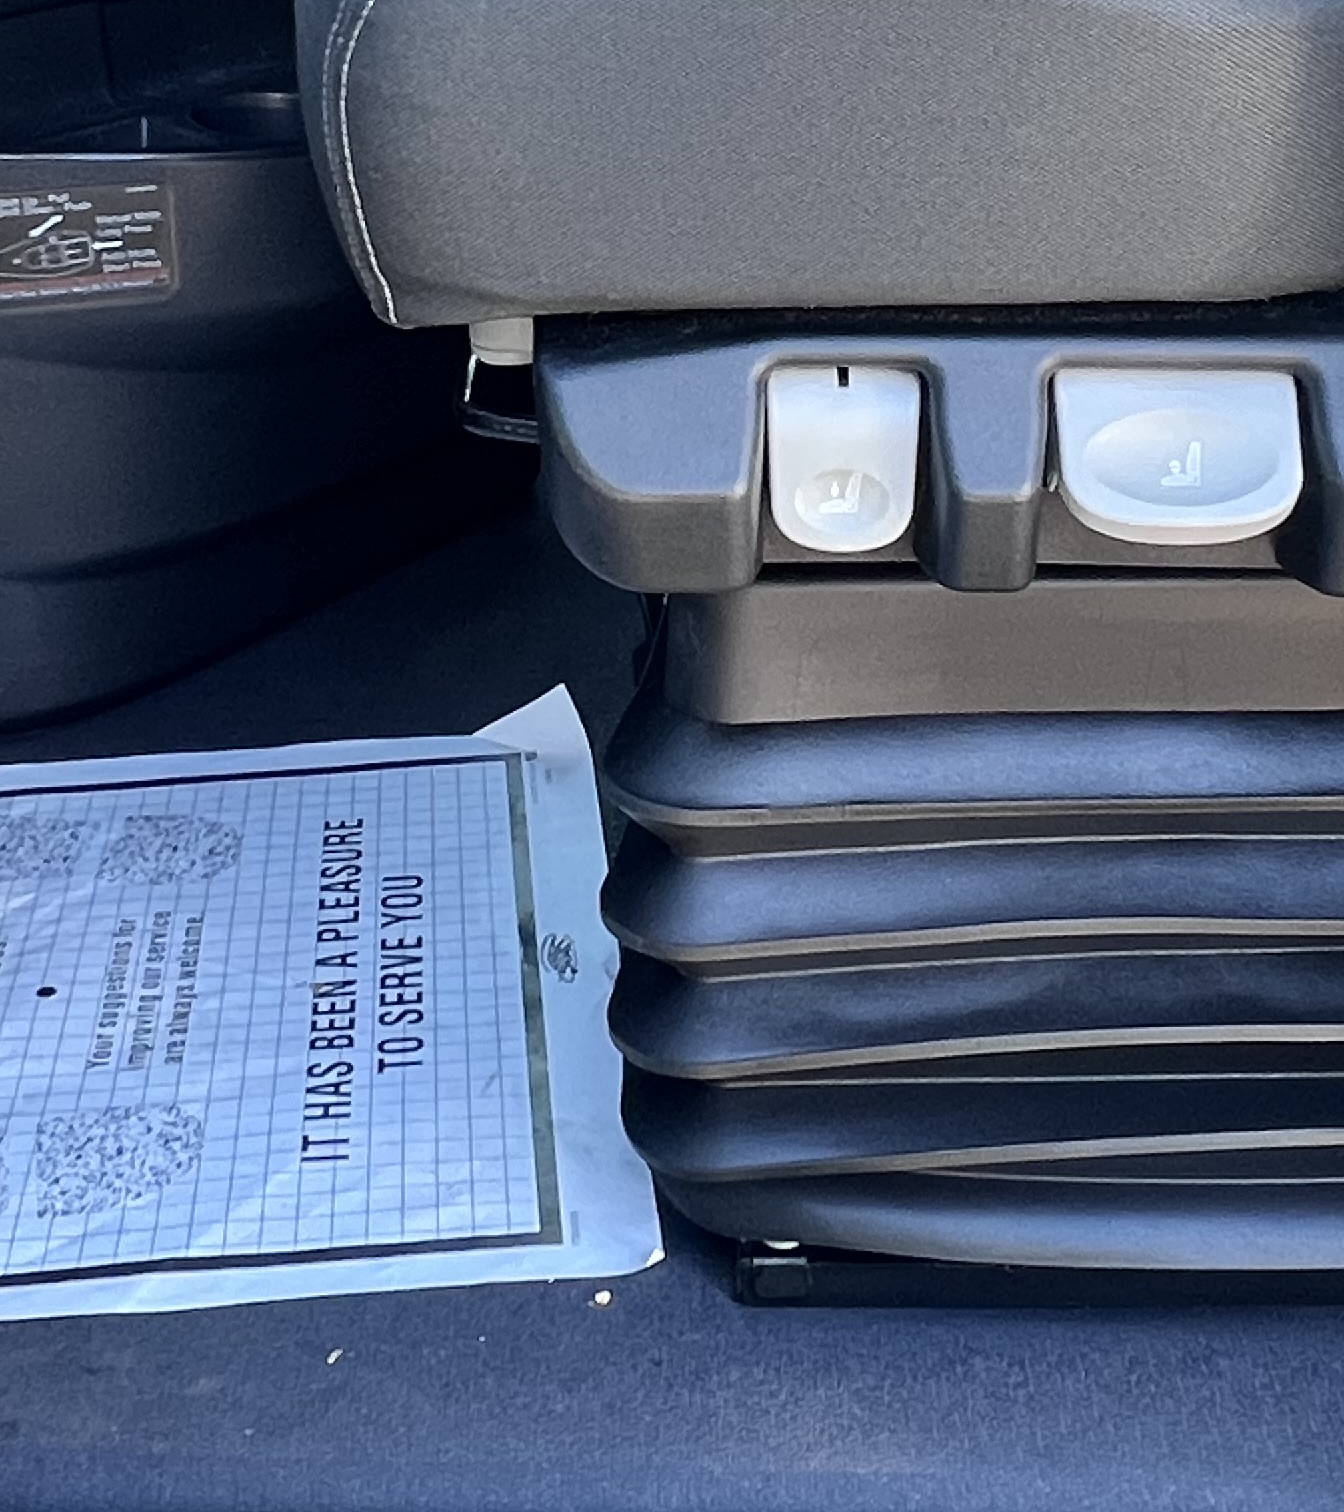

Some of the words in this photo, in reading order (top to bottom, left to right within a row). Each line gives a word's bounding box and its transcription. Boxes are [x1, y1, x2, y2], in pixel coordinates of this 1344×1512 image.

[316, 818, 365, 942] PLEASURE
[378, 874, 425, 928] YOU
[113, 918, 137, 938] for
[146, 911, 172, 962] service
[99, 942, 132, 1027] suggestions
[139, 966, 163, 990] our
[315, 952, 359, 969] A
[378, 936, 425, 1026] SERVE
[126, 994, 163, 1070] improving
[166, 984, 198, 1036] always
[308, 979, 359, 1050] BEEN
[86, 1033, 117, 1070] Your
[163, 1040, 186, 1065] are
[376, 1037, 425, 1075] TO
[303, 1061, 355, 1122] HAS
[300, 1134, 351, 1164] IT
